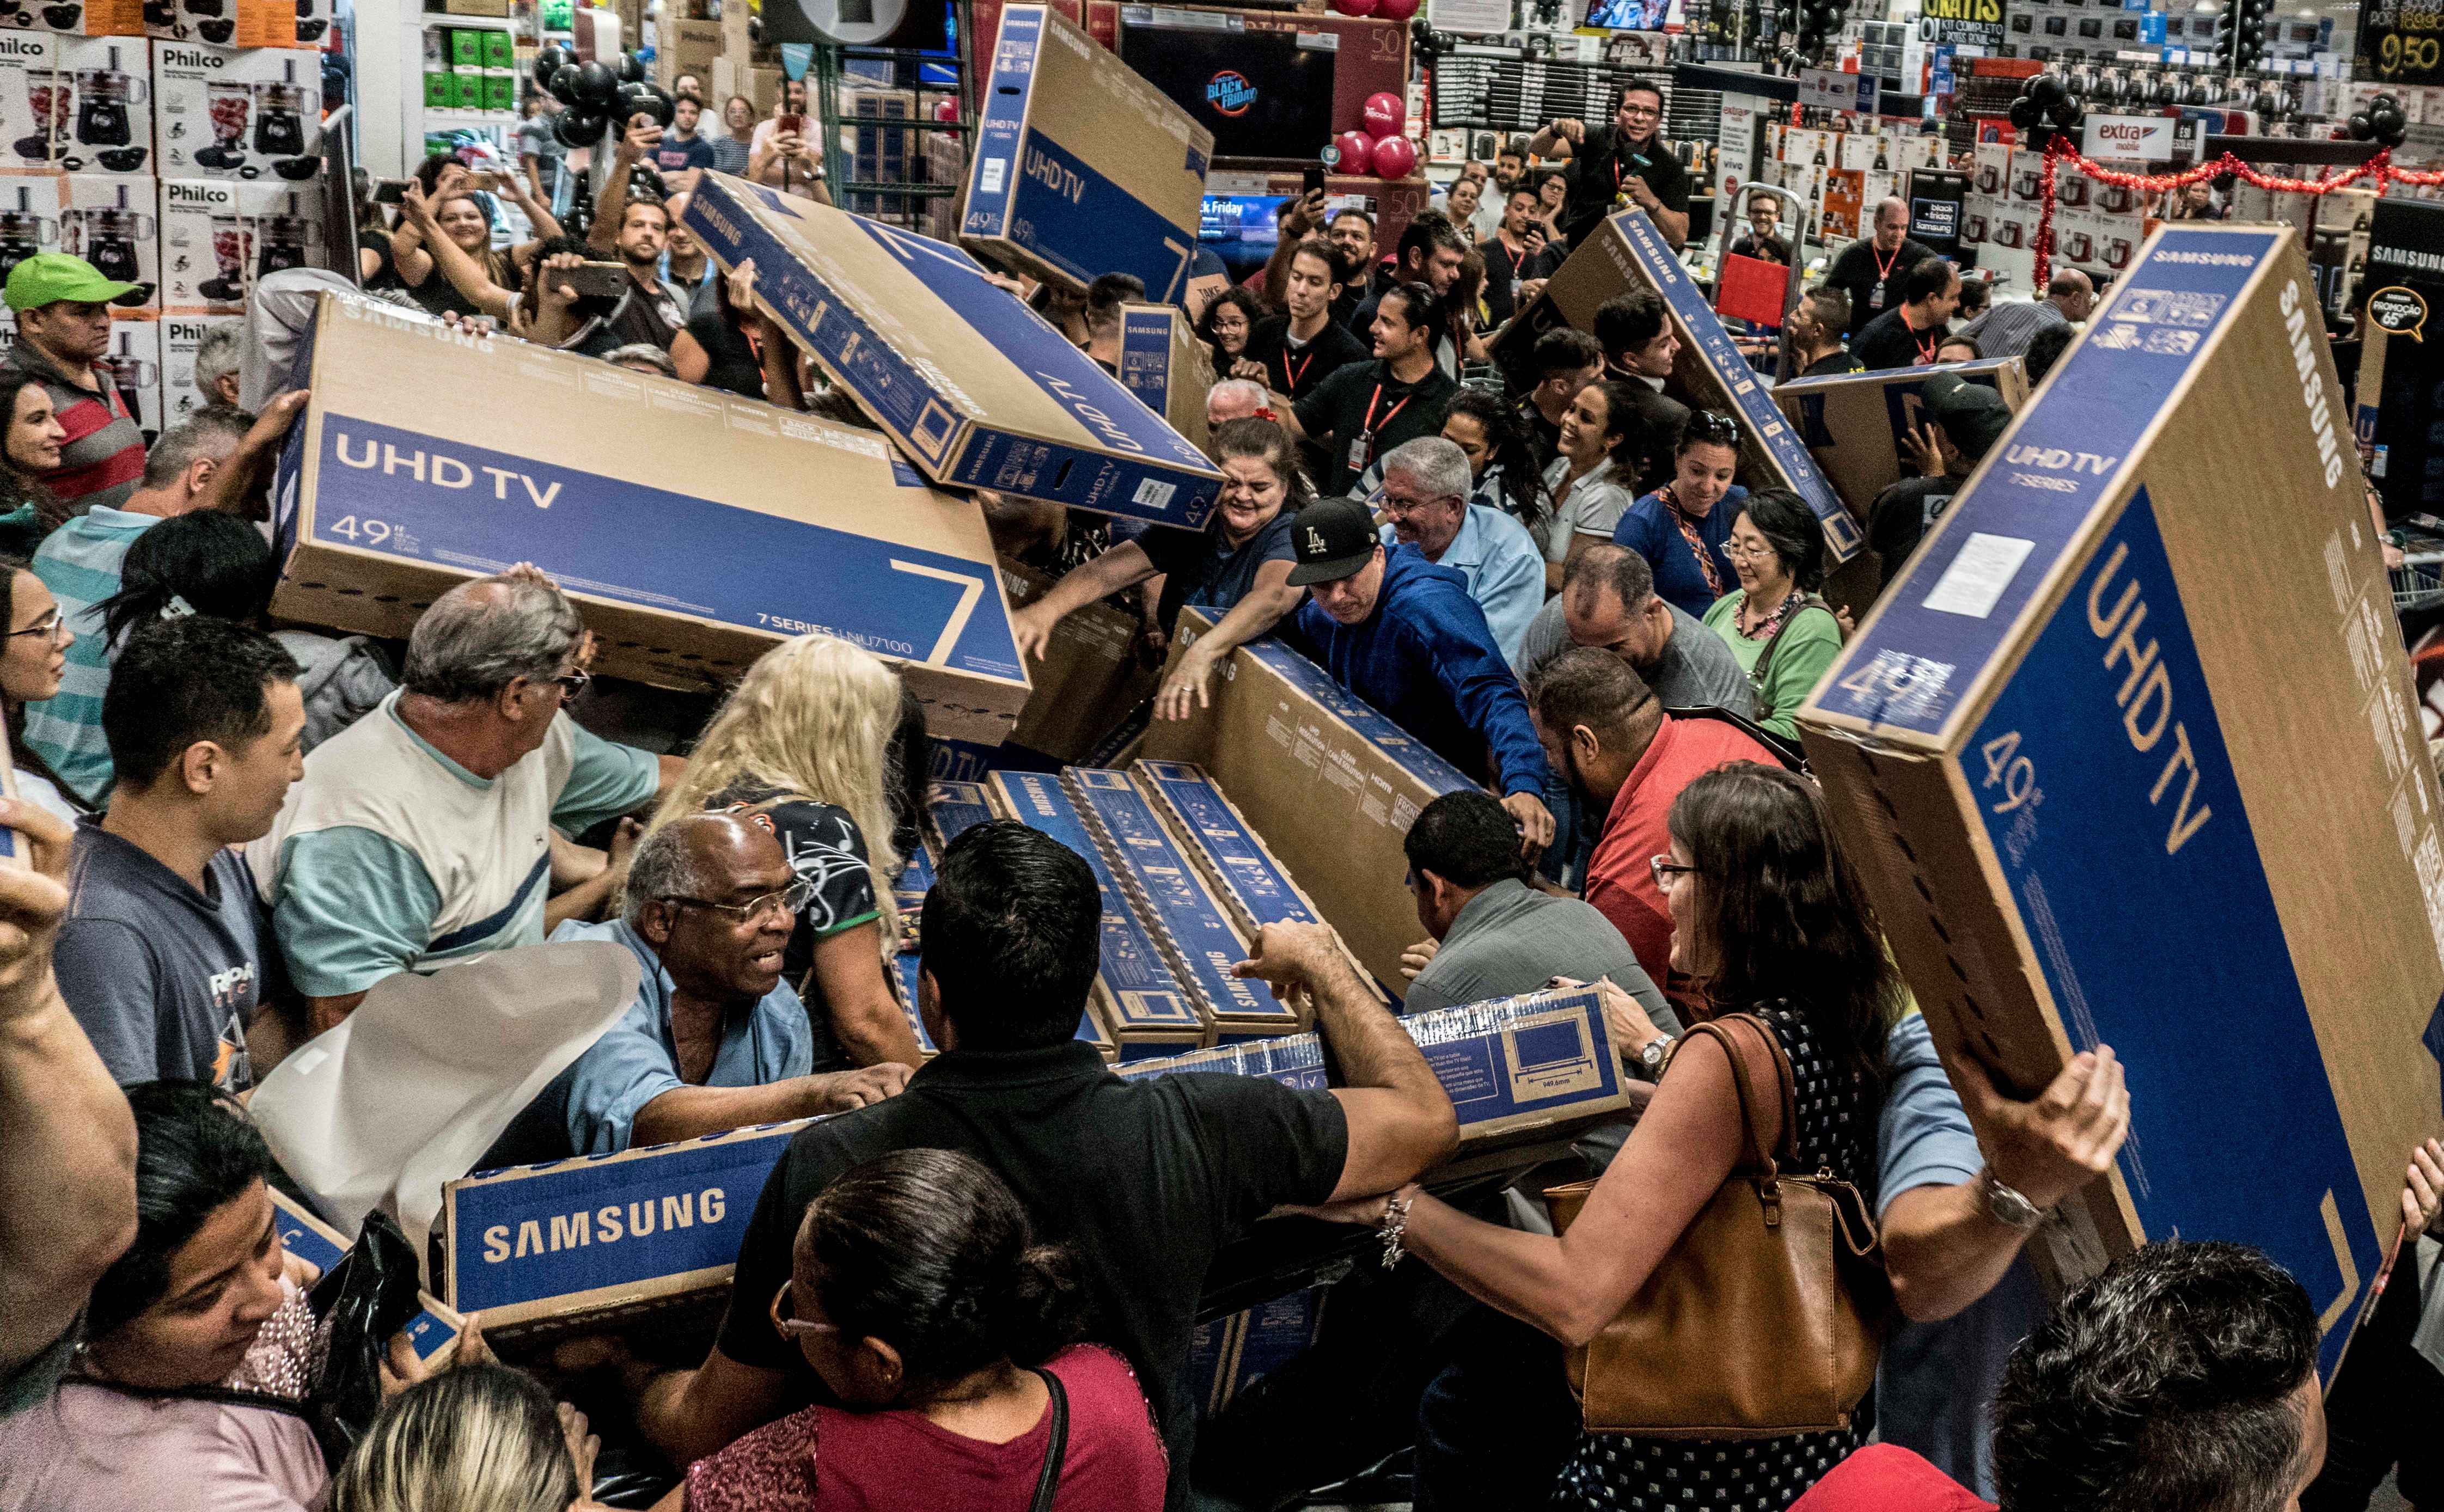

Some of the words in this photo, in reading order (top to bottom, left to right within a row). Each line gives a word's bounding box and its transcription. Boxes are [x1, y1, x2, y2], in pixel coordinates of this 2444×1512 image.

[1372, 29, 1400, 53] 50
[163, 50, 224, 68] Philco
[1207, 79, 1242, 100] BLACK
[1221, 87, 1256, 109] FRIDAY
[2099, 123, 2140, 140] extra
[1024, 145, 1062, 191] UHD
[1061, 165, 1086, 206] TV
[1724, 157, 1743, 170] vivo
[168, 186, 228, 202] Philco
[1212, 201, 1243, 216] Friday
[1931, 204, 1953, 212] black
[693, 194, 742, 247] SAMSUNG
[1916, 222, 1952, 234] Samsung
[1629, 219, 1677, 284] SAMSUNG
[2153, 250, 2256, 267] SAMSUNG
[2373, 300, 2422, 316] PROMOÇÃO
[343, 303, 496, 354] SAMSUNG
[1127, 325, 1168, 335] SAMSUNG
[2279, 279, 2343, 489] SAMSUNG
[1036, 370, 1086, 399] TV
[1074, 402, 1143, 451] UHD
[786, 419, 814, 432] BACK
[334, 433, 473, 489] UHD
[482, 466, 562, 509] TV
[2006, 444, 2074, 470] UHD
[2073, 451, 2117, 476] TV
[1085, 477, 1106, 504] UHD
[1307, 527, 1327, 554] LA
[890, 558, 984, 666] 7
[757, 613, 769, 624] 7
[771, 616, 833, 636] SERIES
[2087, 544, 2173, 752] UHD
[2149, 721, 2212, 855] TV
[1340, 749, 1357, 765] CLEAN
[1981, 730, 2034, 814] 49
[1021, 775, 1057, 816] SAMSUNG
[1205, 951, 1258, 1007] SAMSUNG
[1543, 1078, 1571, 1088] 949.6mm
[482, 1187, 726, 1264] SAMSUNG
